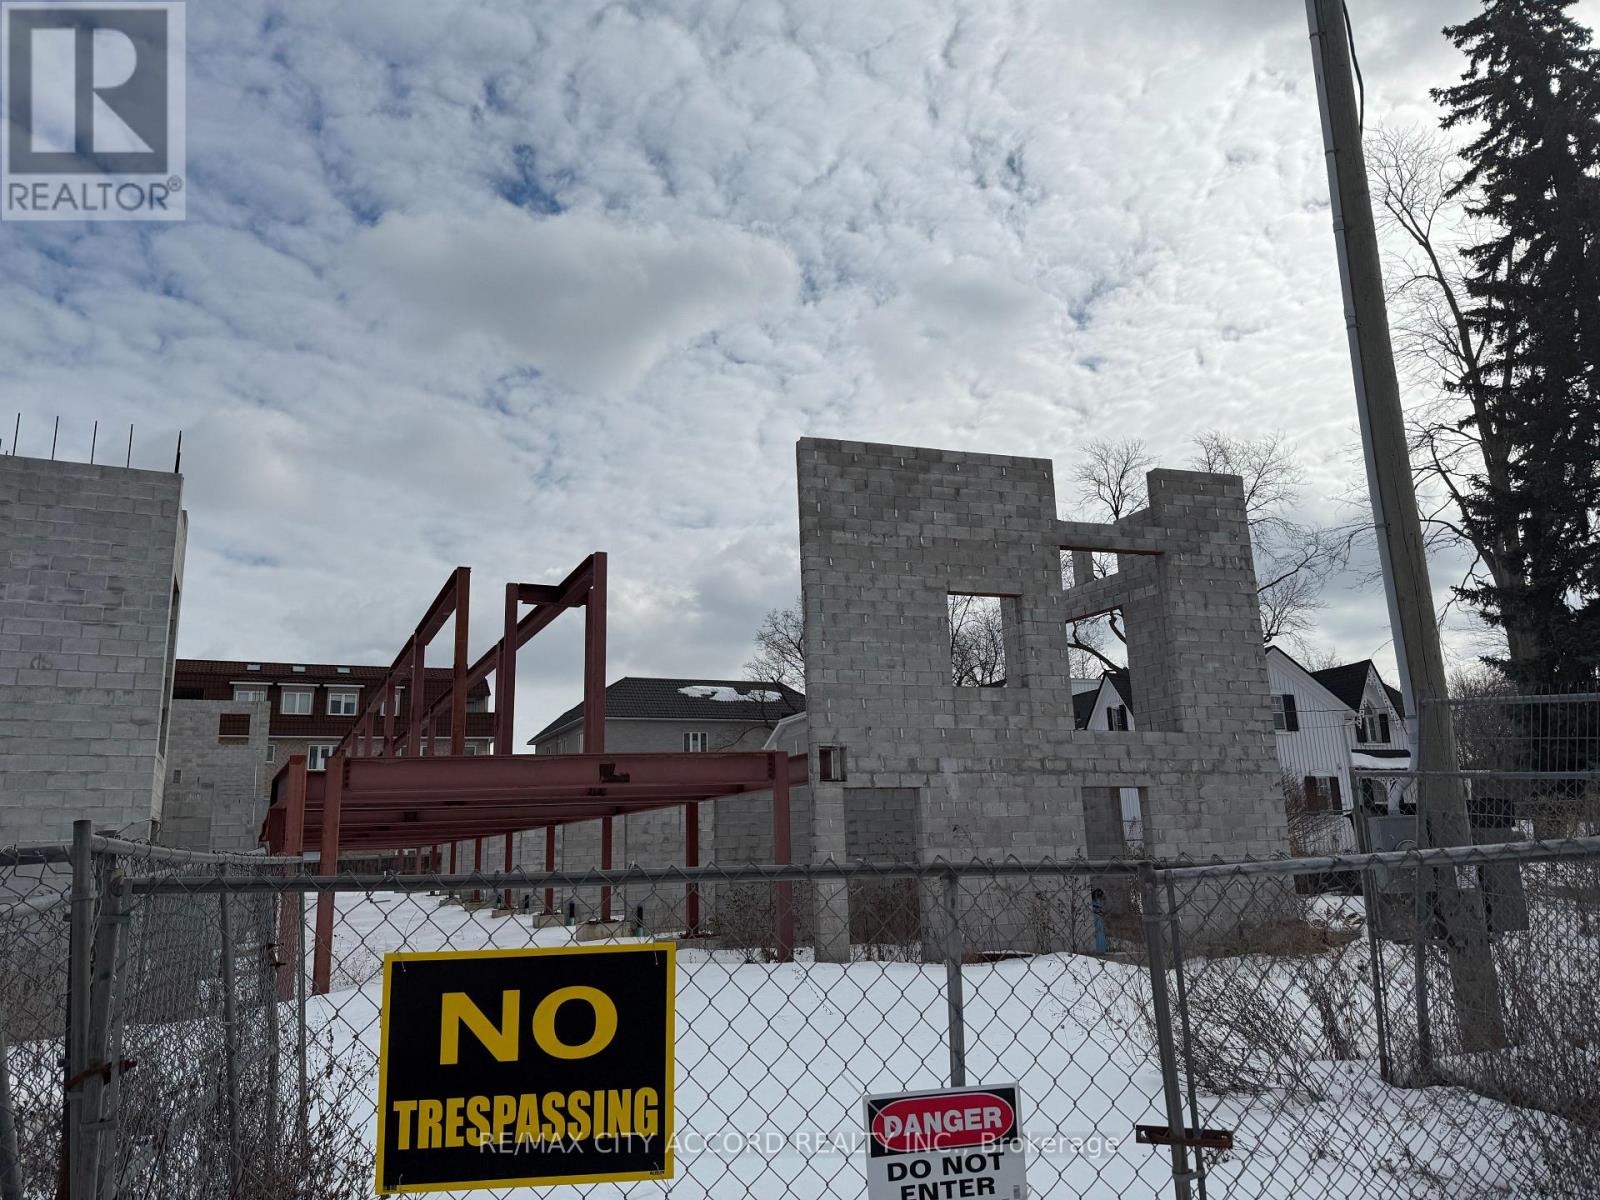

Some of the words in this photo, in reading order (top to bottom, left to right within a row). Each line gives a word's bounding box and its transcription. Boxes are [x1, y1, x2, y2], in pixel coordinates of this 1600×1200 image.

[440, 985, 618, 1065] NO
[393, 1087, 659, 1150] TRESPASSING
[883, 1106, 1003, 1138] DANGER
[887, 1159, 932, 1181] DO
[942, 1152, 1005, 1175] NOT
[900, 1177, 996, 1200] ENTER
